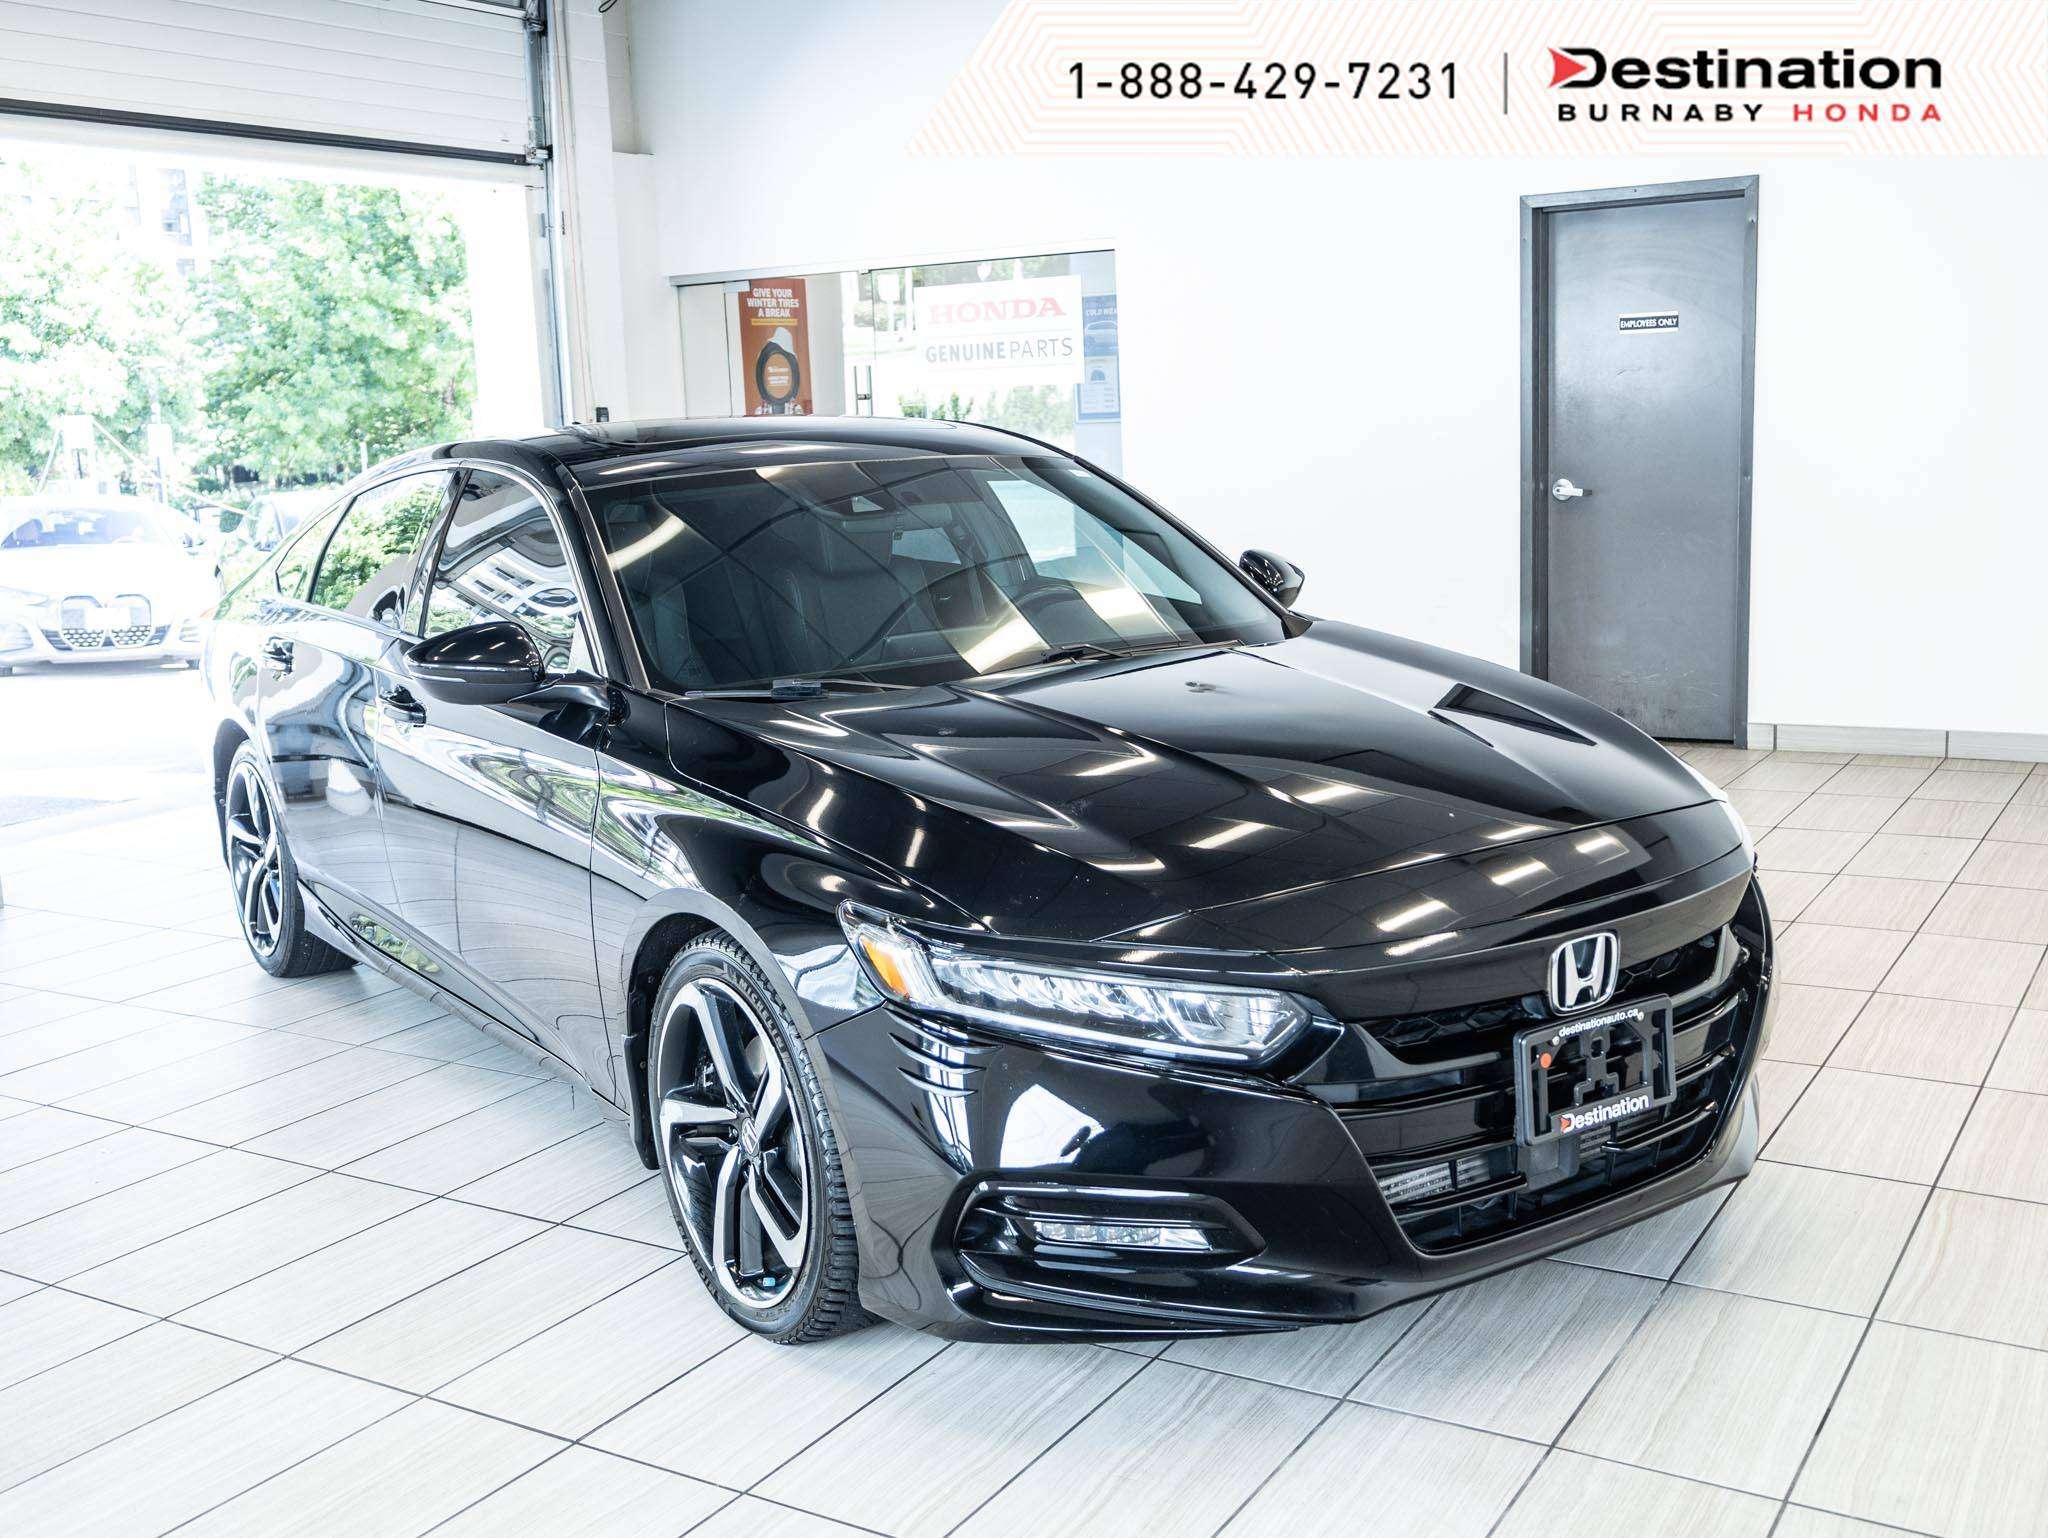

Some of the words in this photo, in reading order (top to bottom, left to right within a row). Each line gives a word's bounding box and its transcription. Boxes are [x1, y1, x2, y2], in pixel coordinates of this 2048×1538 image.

[752, 288, 771, 297] GIVE
[772, 288, 792, 297] YOUR
[747, 298, 777, 307] WINTER
[778, 298, 800, 307] TIRES
[928, 298, 1066, 326] HONDA
[758, 308, 764, 317] A
[765, 308, 790, 318] BREAK
[1620, 319, 1657, 328] EMPLOYEES
[1657, 318, 1678, 327] ONLY
[738, 976, 788, 1053] MICHELIN
[1558, 1008, 1639, 1037] destinationauto.ca
[1560, 1094, 1650, 1133] Destination
